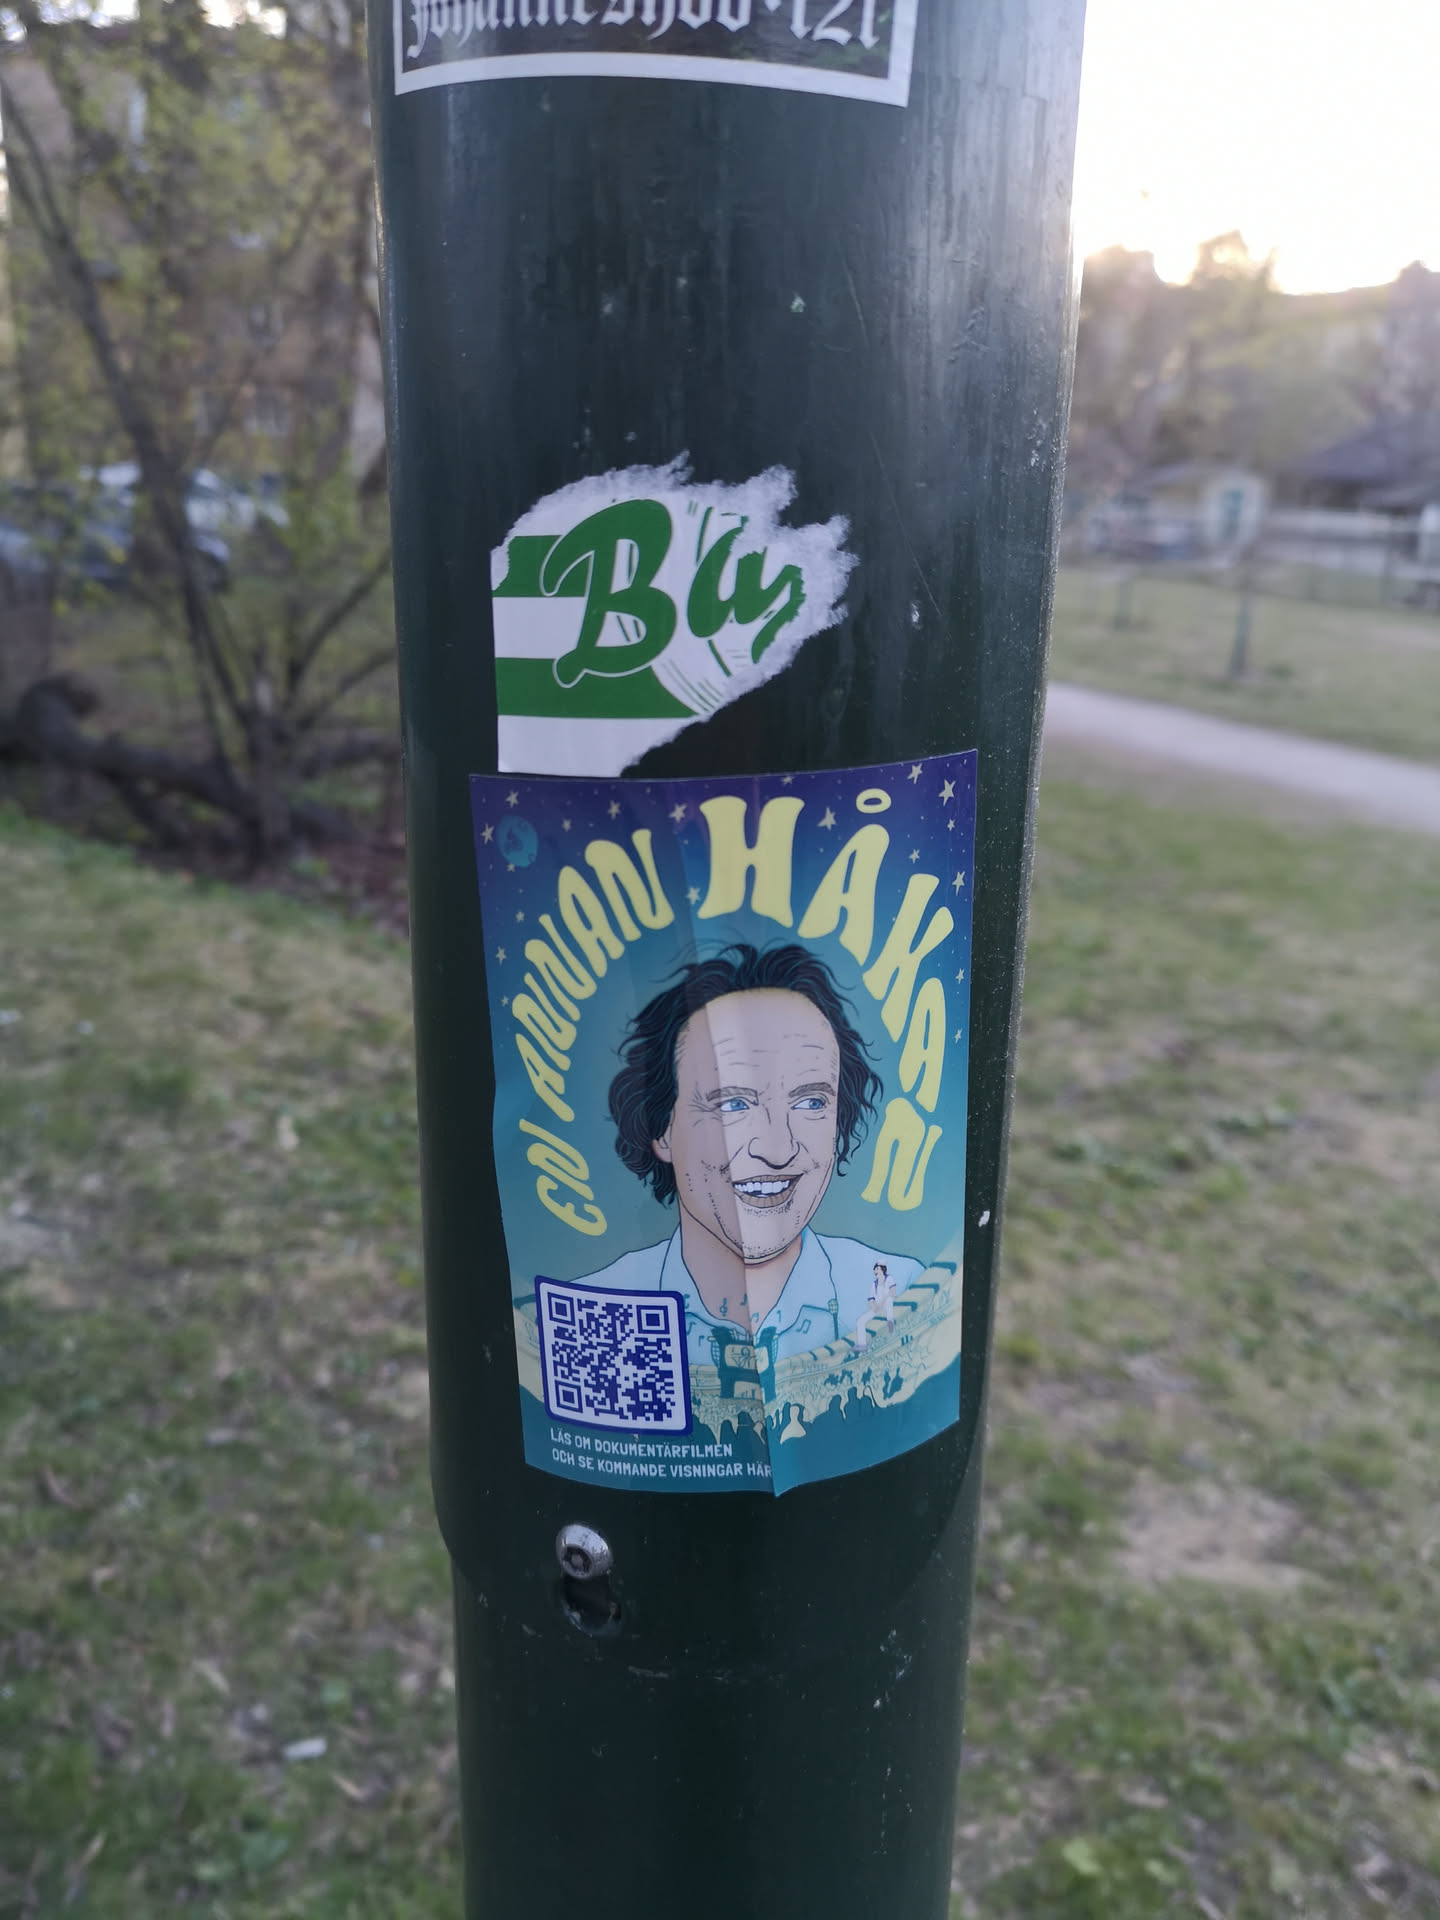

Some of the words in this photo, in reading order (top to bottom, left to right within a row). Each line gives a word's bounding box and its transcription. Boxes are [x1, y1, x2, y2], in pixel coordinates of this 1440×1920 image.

[512, 828, 675, 1123] ANNAN
[697, 788, 955, 1212] HÅKAN
[518, 1118, 608, 1236] EN
[550, 1427, 572, 1446] LÄS
[574, 1435, 591, 1450] OM
[594, 1439, 733, 1459] DOKUMENTÄRFILMEN
[552, 1448, 575, 1466] OCH
[578, 1455, 595, 1470] SE
[597, 1459, 667, 1478] KOMMANDE
[670, 1462, 743, 1478] VISNINGAR
[747, 1460, 773, 1478] HÄR
